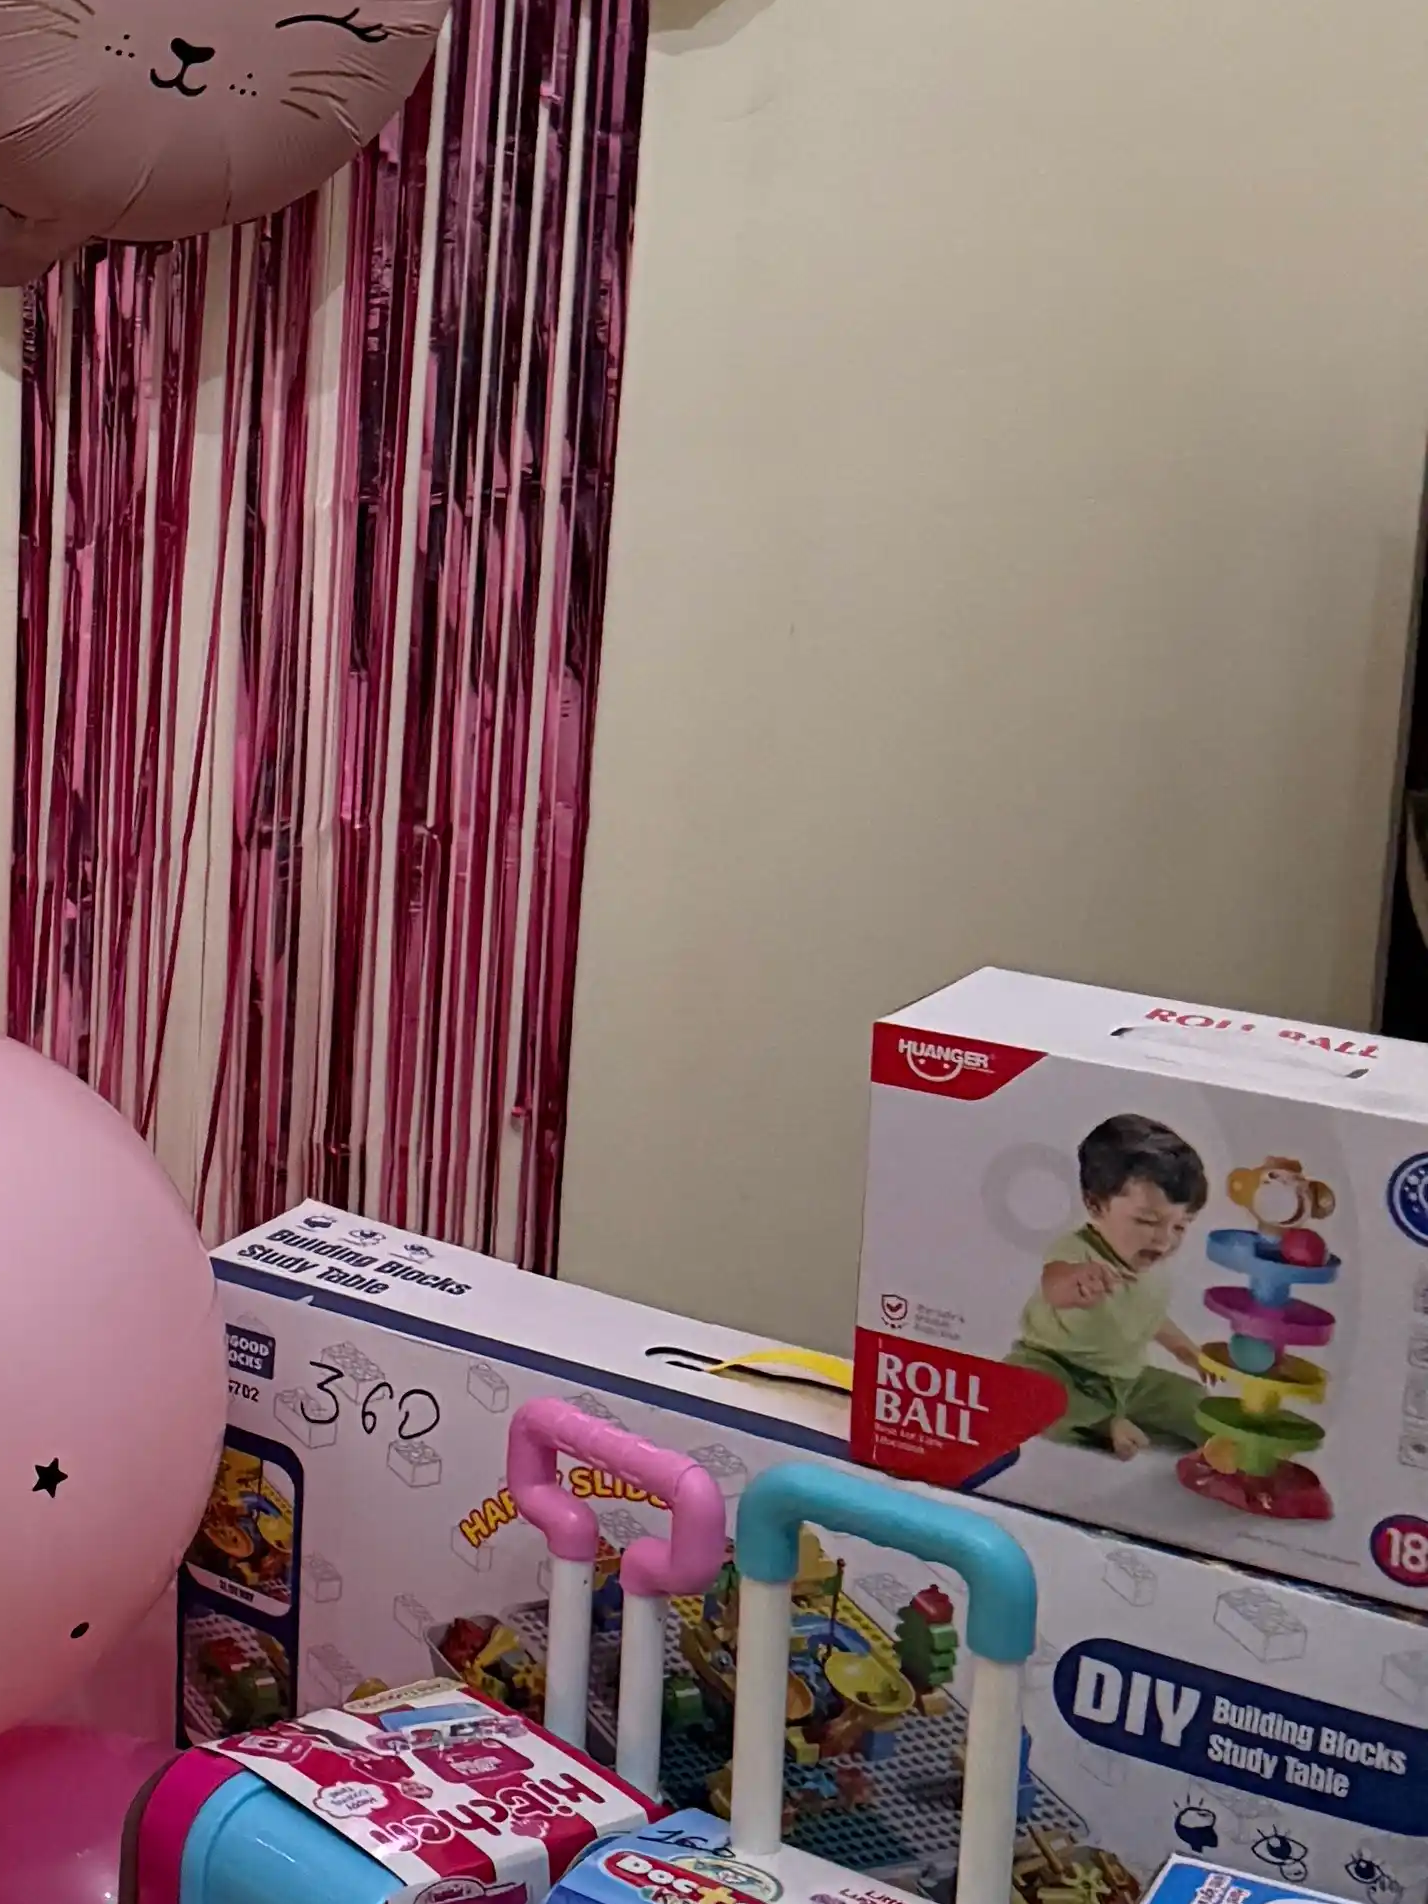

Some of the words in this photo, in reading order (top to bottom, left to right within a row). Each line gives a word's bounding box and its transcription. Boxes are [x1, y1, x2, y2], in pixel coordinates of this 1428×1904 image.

[899, 1037, 989, 1070] HUANGER
[237, 1242, 315, 1276] Study
[316, 1265, 390, 1296] Table
[266, 1228, 379, 1269] Building
[374, 1260, 473, 1298] Blocks
[300, 1360, 440, 1440] 360
[876, 1351, 990, 1413] ROLL
[875, 1387, 980, 1446] BALL
[1073, 1654, 1202, 1748] DIY
[1207, 1732, 1278, 1780] Study
[1284, 1755, 1350, 1798] Table
[1211, 1695, 1315, 1751] Building
[1318, 1726, 1408, 1776] Blocks
